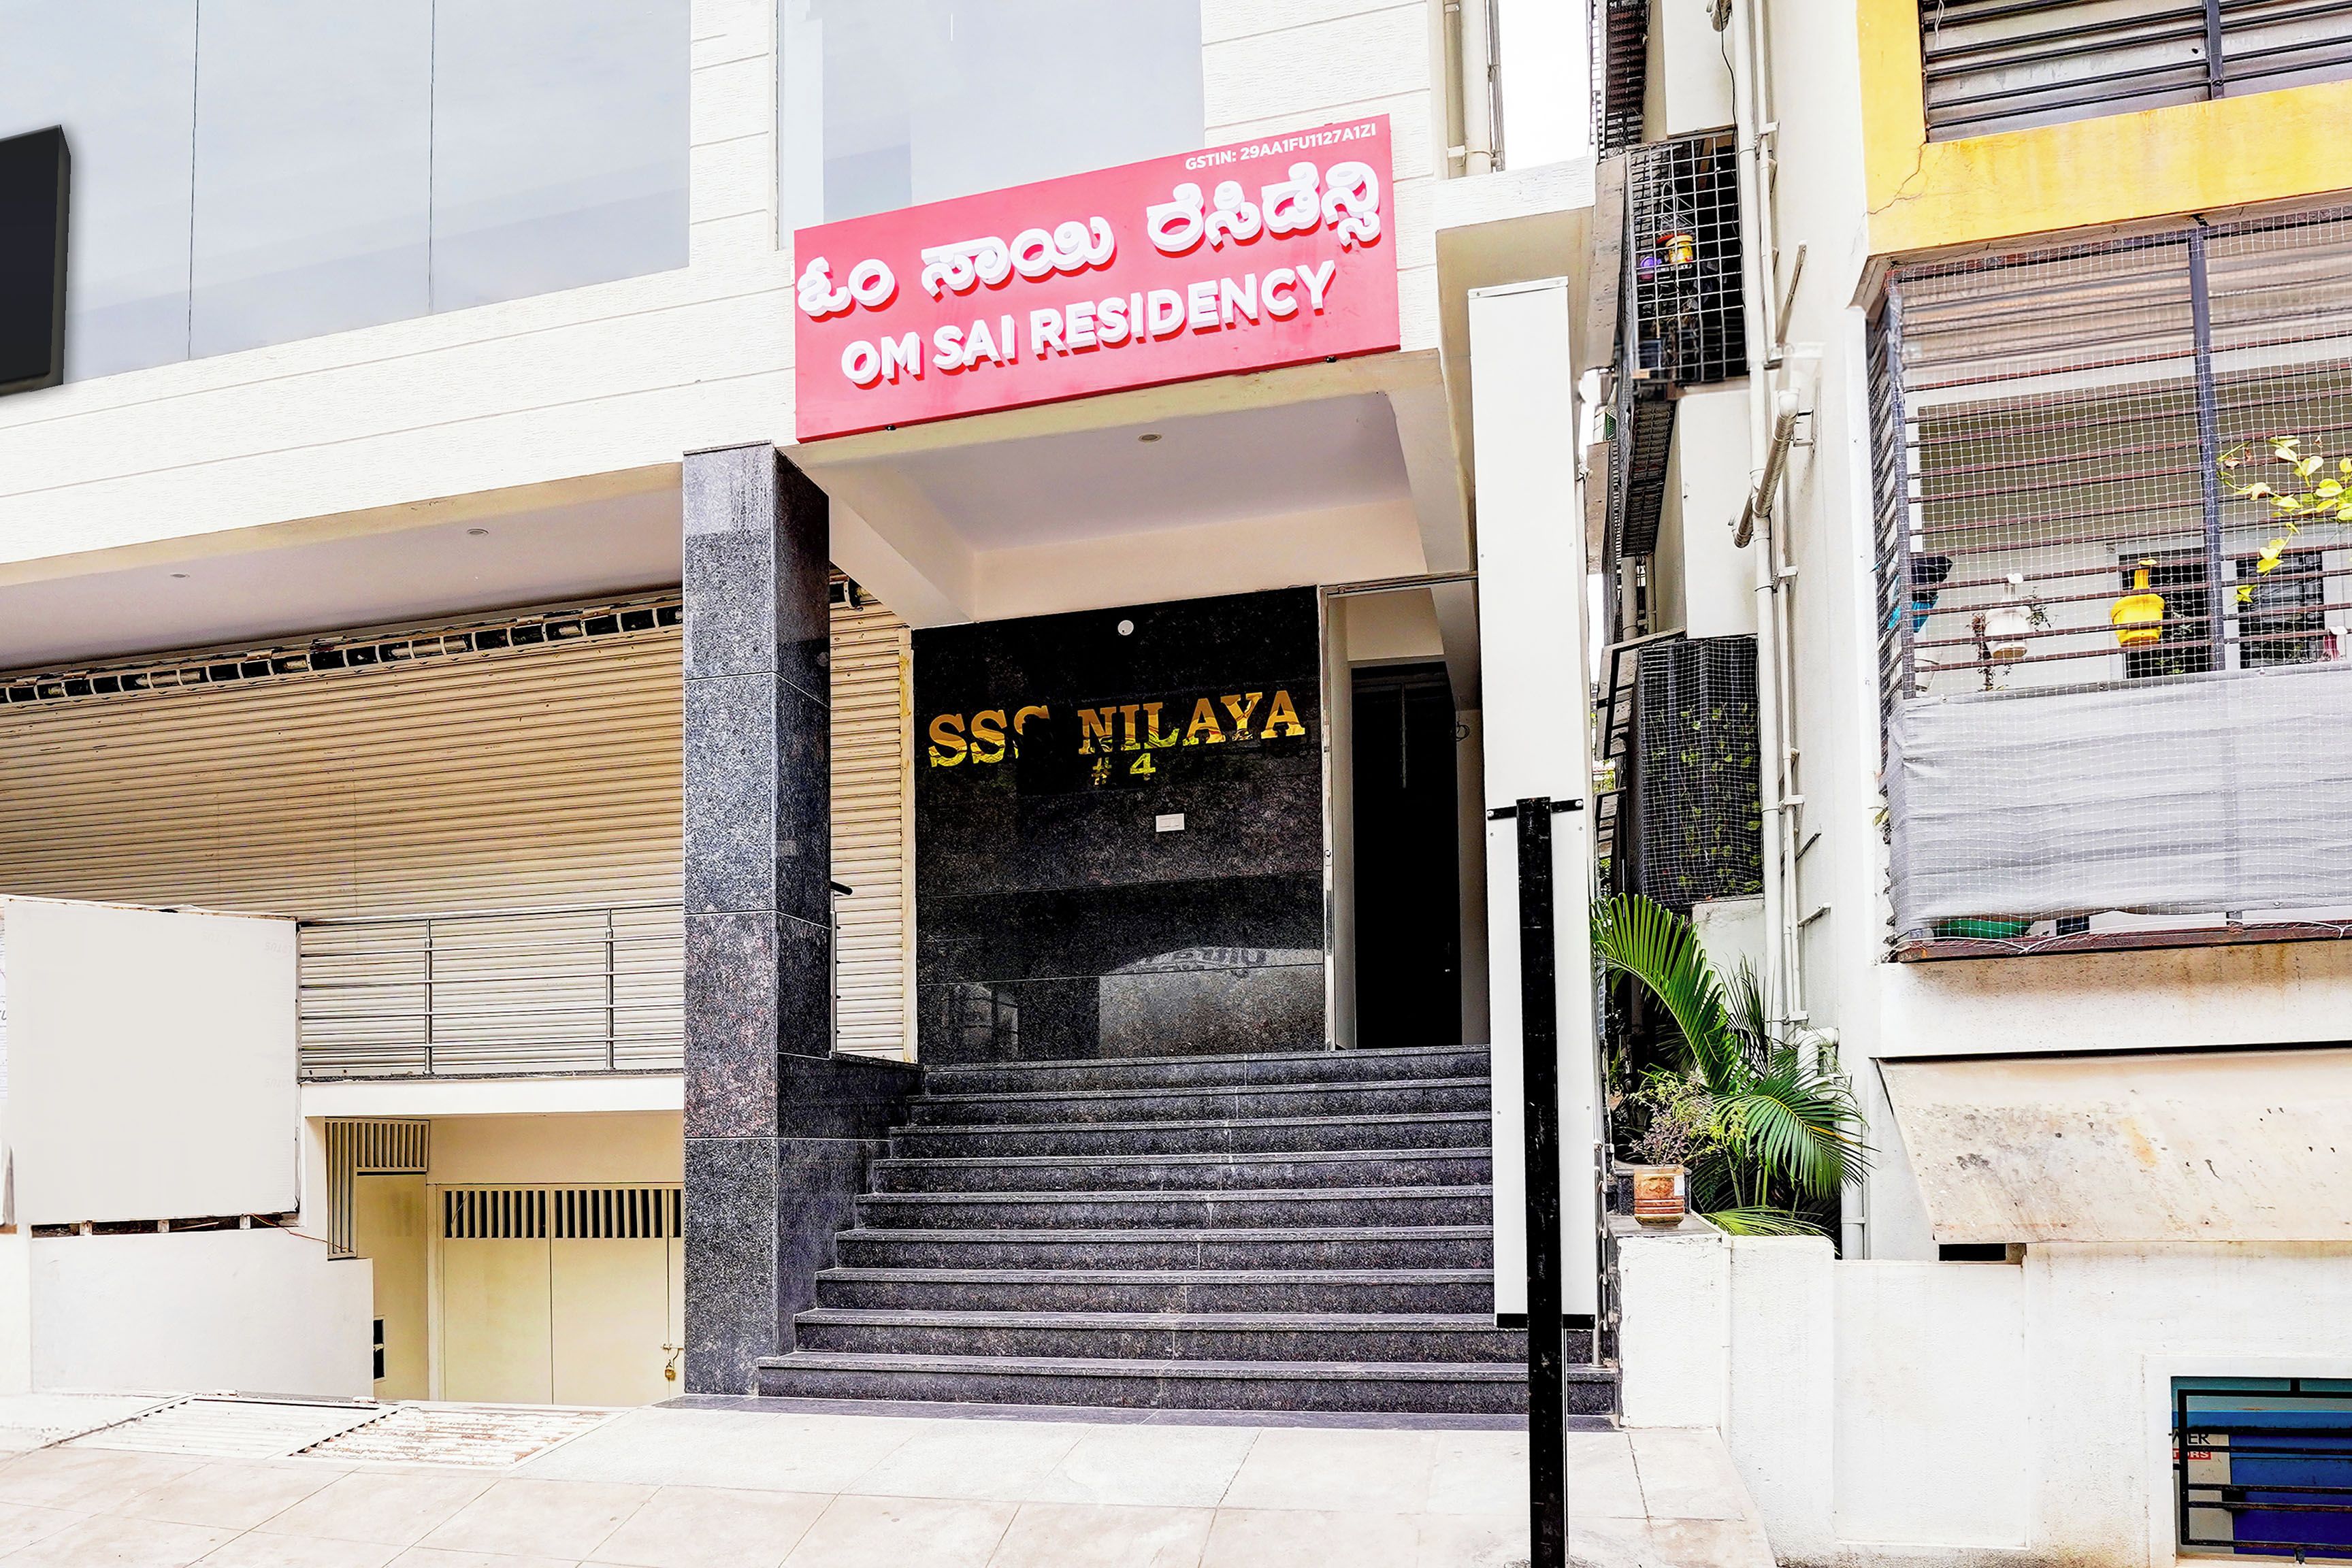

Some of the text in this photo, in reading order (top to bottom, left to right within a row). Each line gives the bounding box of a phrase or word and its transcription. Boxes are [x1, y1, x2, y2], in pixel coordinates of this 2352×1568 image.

[1185, 150, 1237, 170] GSTIN:
[797, 257, 896, 316] ಓಂ
[921, 216, 1115, 297] ಸಾಯಿ
[841, 260, 1336, 385] OM SAI RESIDENCY
[1077, 690, 1305, 755] NILAYA
[1129, 753, 1156, 781] 4
